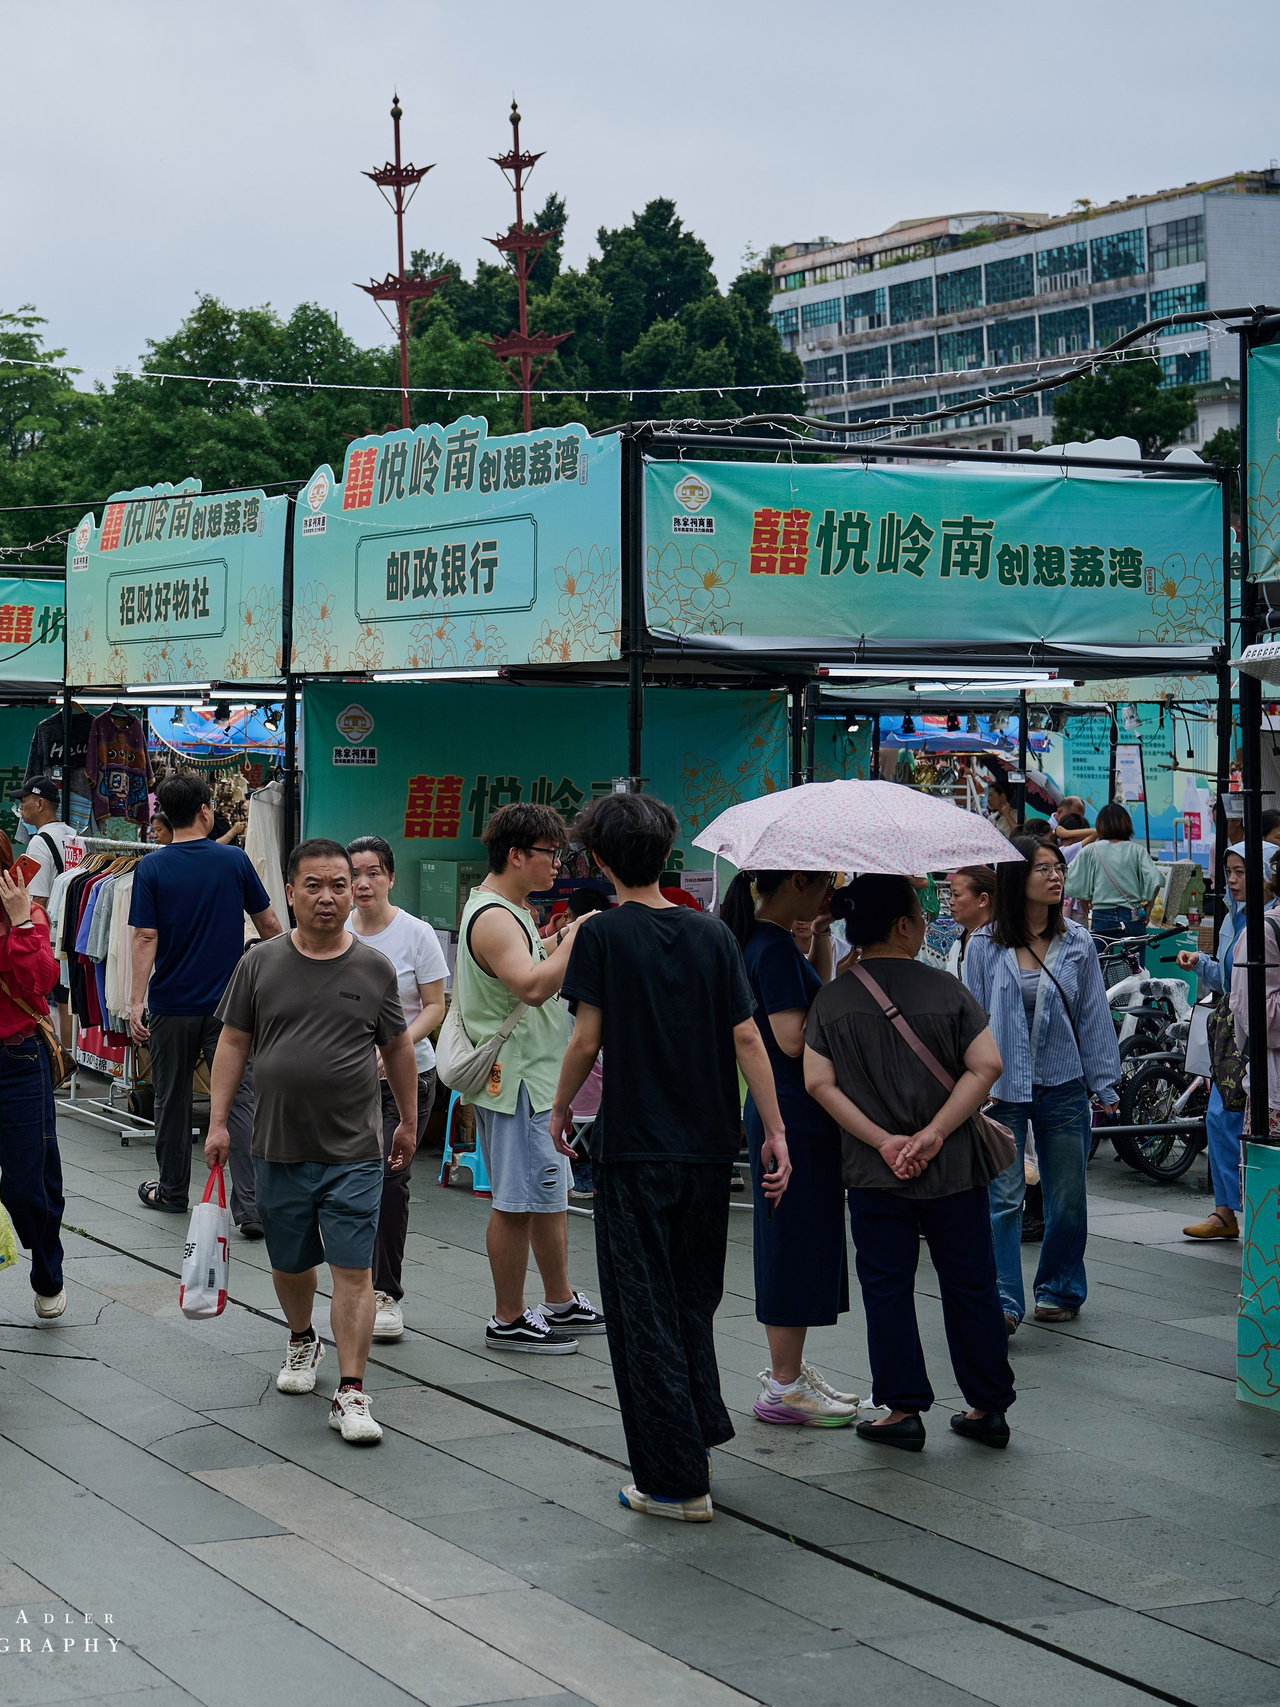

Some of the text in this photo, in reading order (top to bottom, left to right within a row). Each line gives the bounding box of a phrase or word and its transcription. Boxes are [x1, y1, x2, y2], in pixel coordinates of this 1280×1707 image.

[386, 539, 499, 601] 邮政银行
[119, 576, 210, 626] 招财好物社
